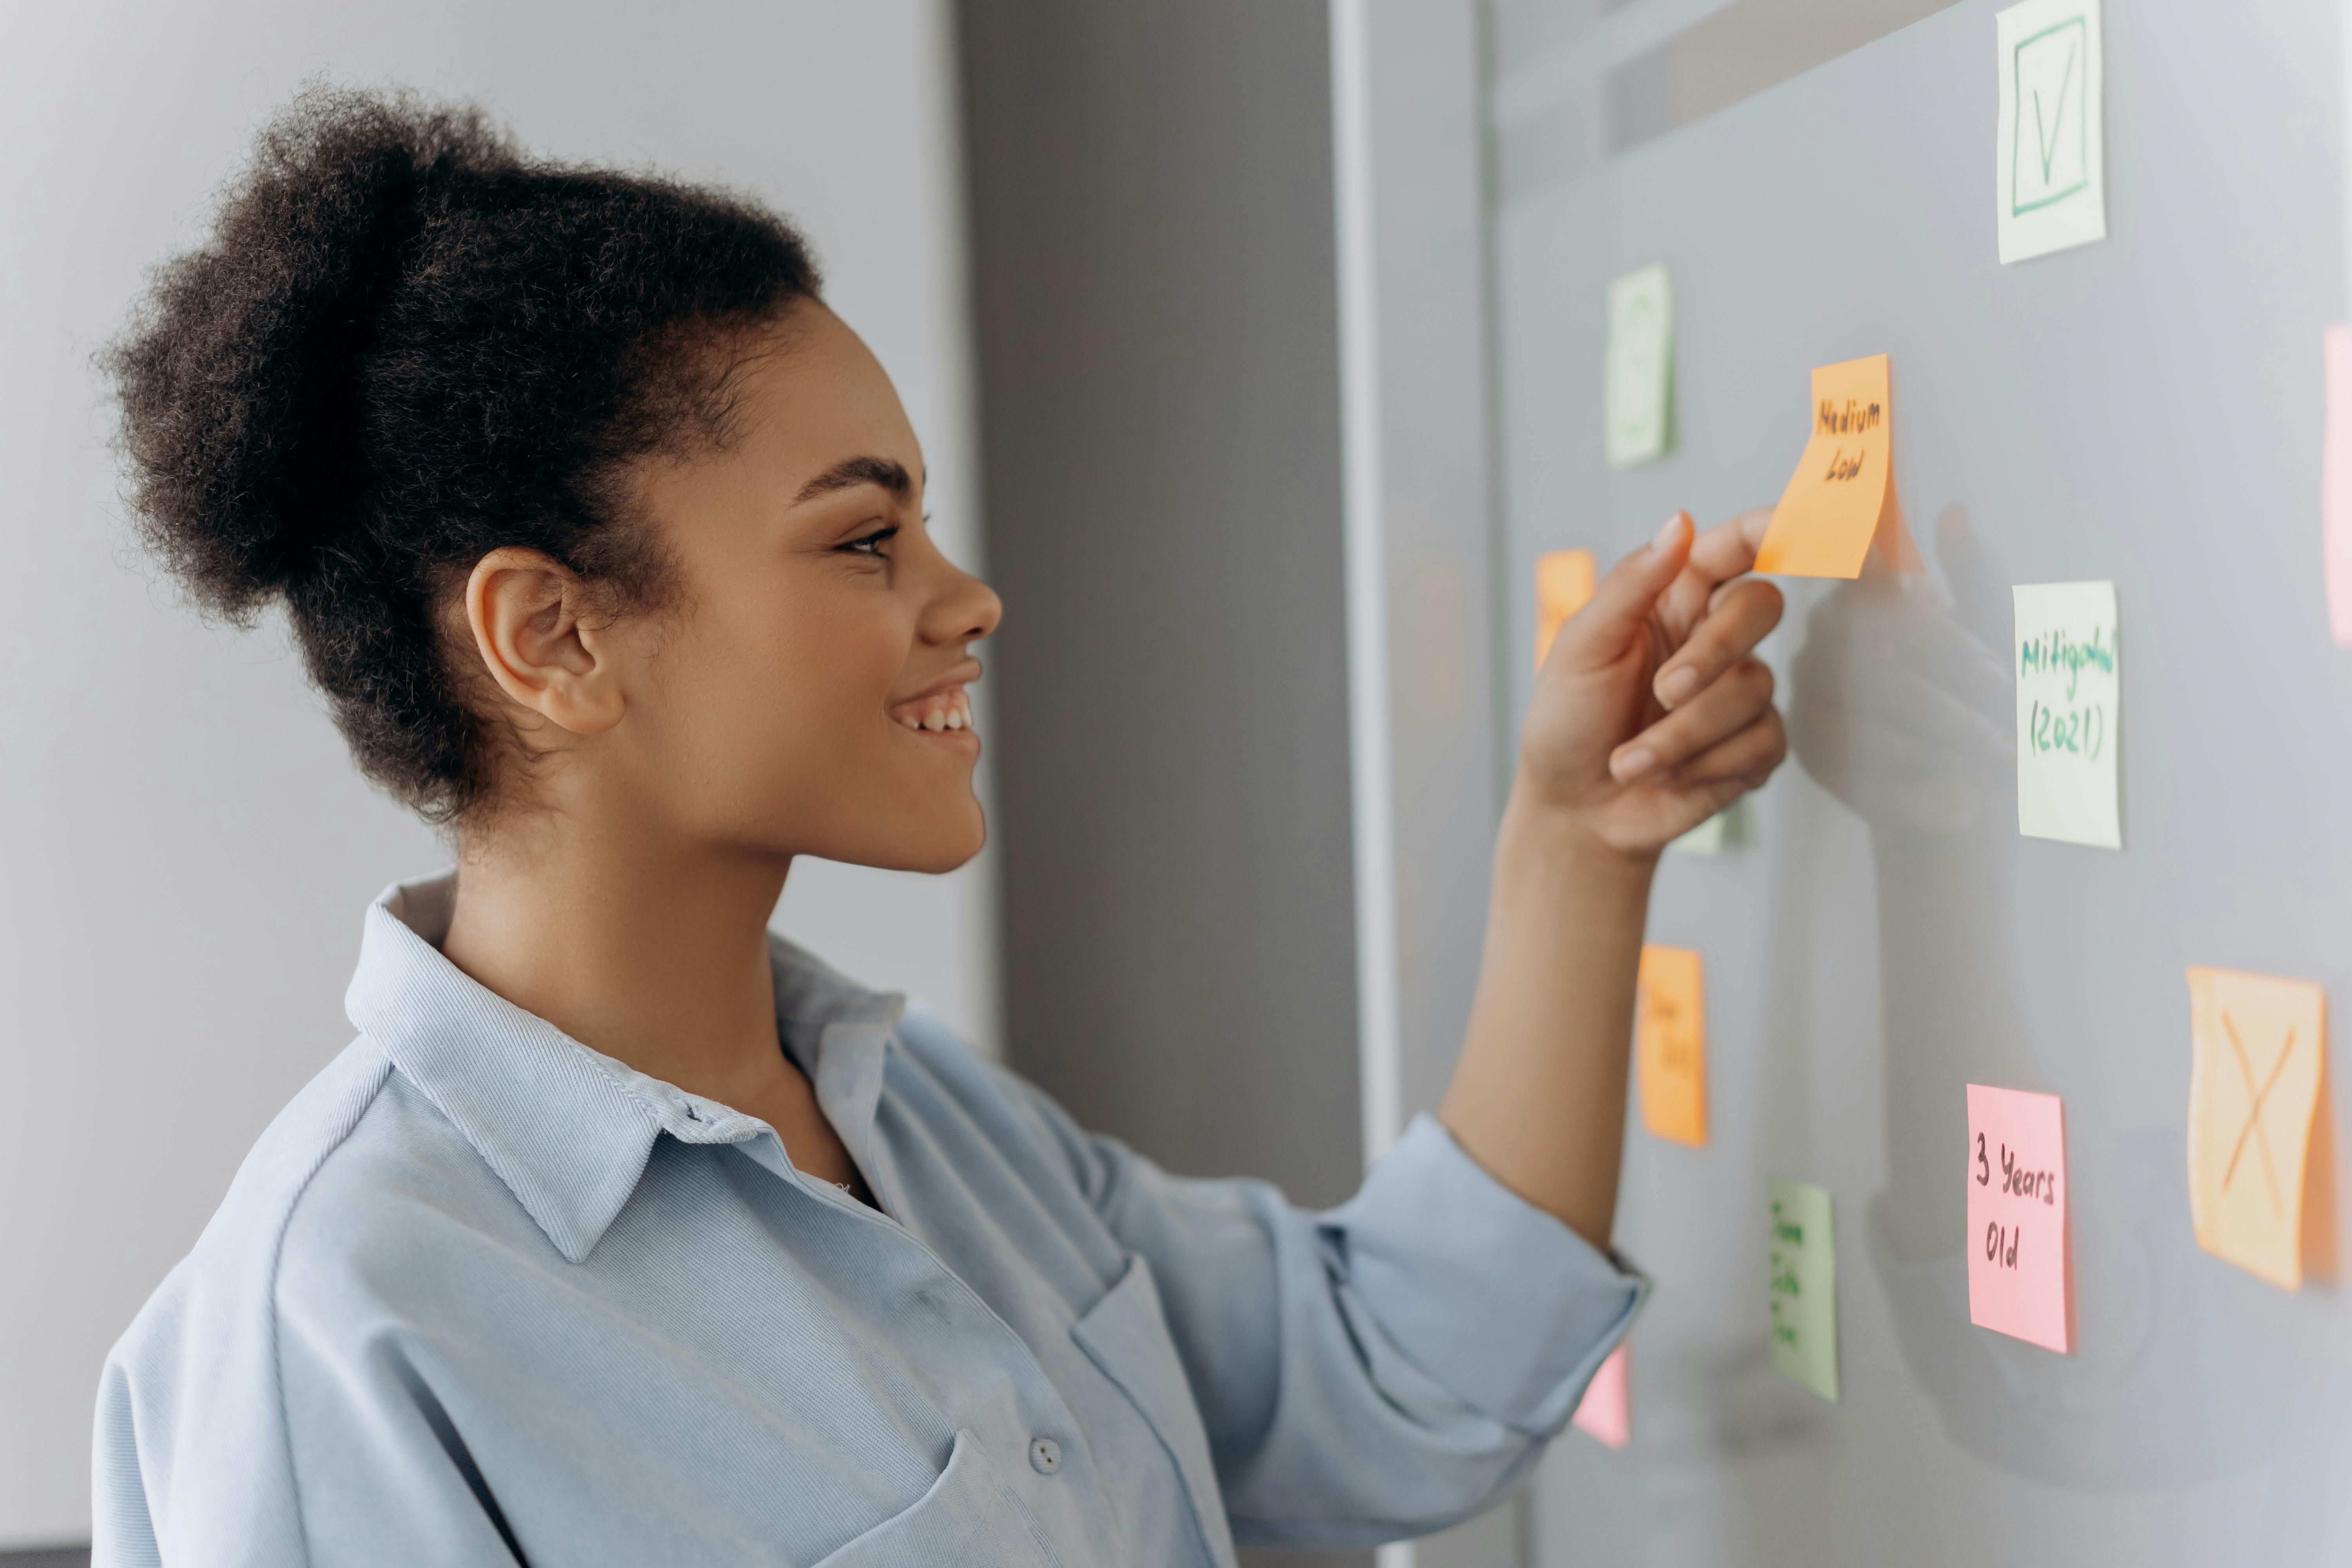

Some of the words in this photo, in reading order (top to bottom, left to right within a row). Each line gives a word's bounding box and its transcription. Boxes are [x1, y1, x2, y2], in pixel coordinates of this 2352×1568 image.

[1816, 398, 1880, 434] Medium
[1824, 448, 1864, 482] Low
[2031, 699, 2102, 761] (2021)
[1976, 1132, 1989, 1187] 3
[2001, 1142, 2054, 1206] Years
[1986, 1220, 2020, 1270] Old
